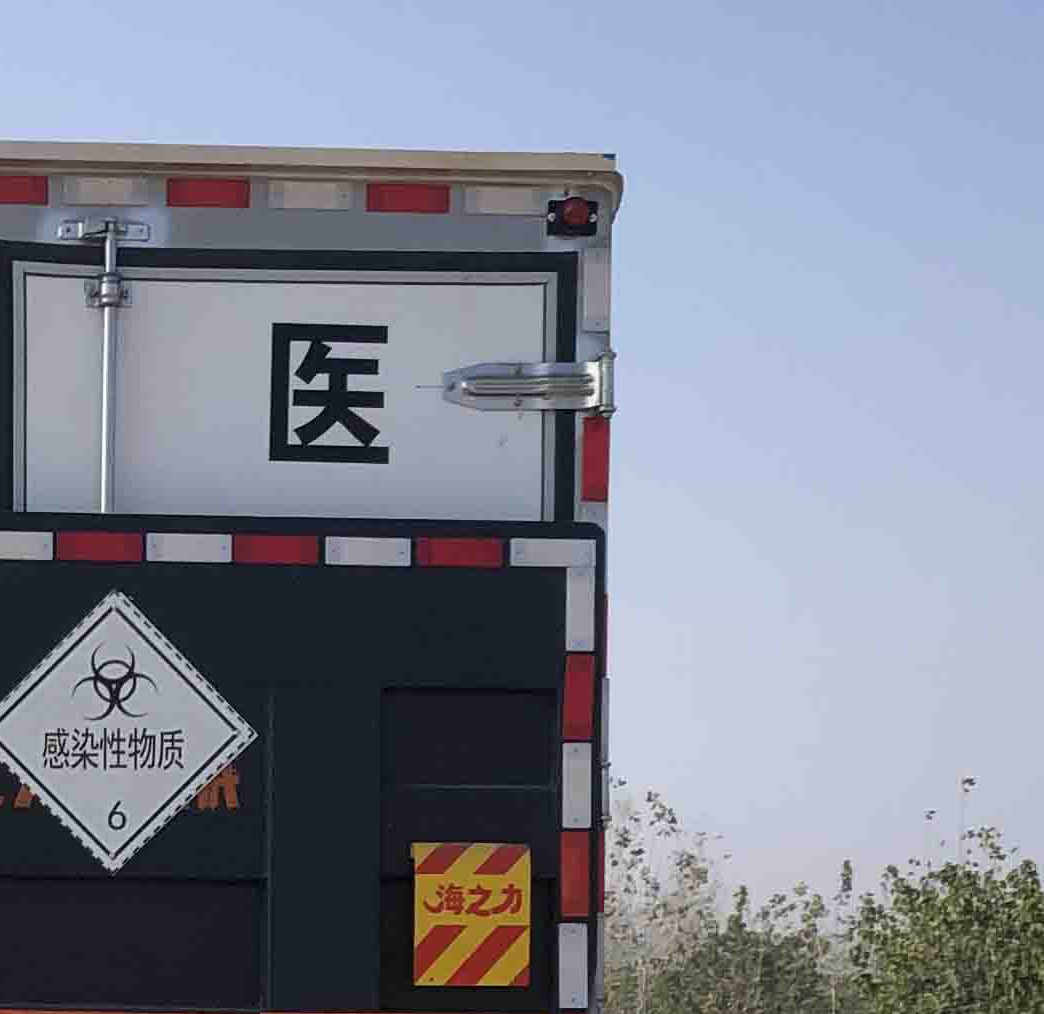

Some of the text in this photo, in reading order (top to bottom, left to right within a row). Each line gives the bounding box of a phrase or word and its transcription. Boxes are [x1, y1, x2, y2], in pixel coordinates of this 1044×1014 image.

[268, 322, 389, 464] 医
[42, 727, 185, 771] 感染性物质
[107, 800, 127, 830] 6
[423, 883, 523, 917] 海之力
